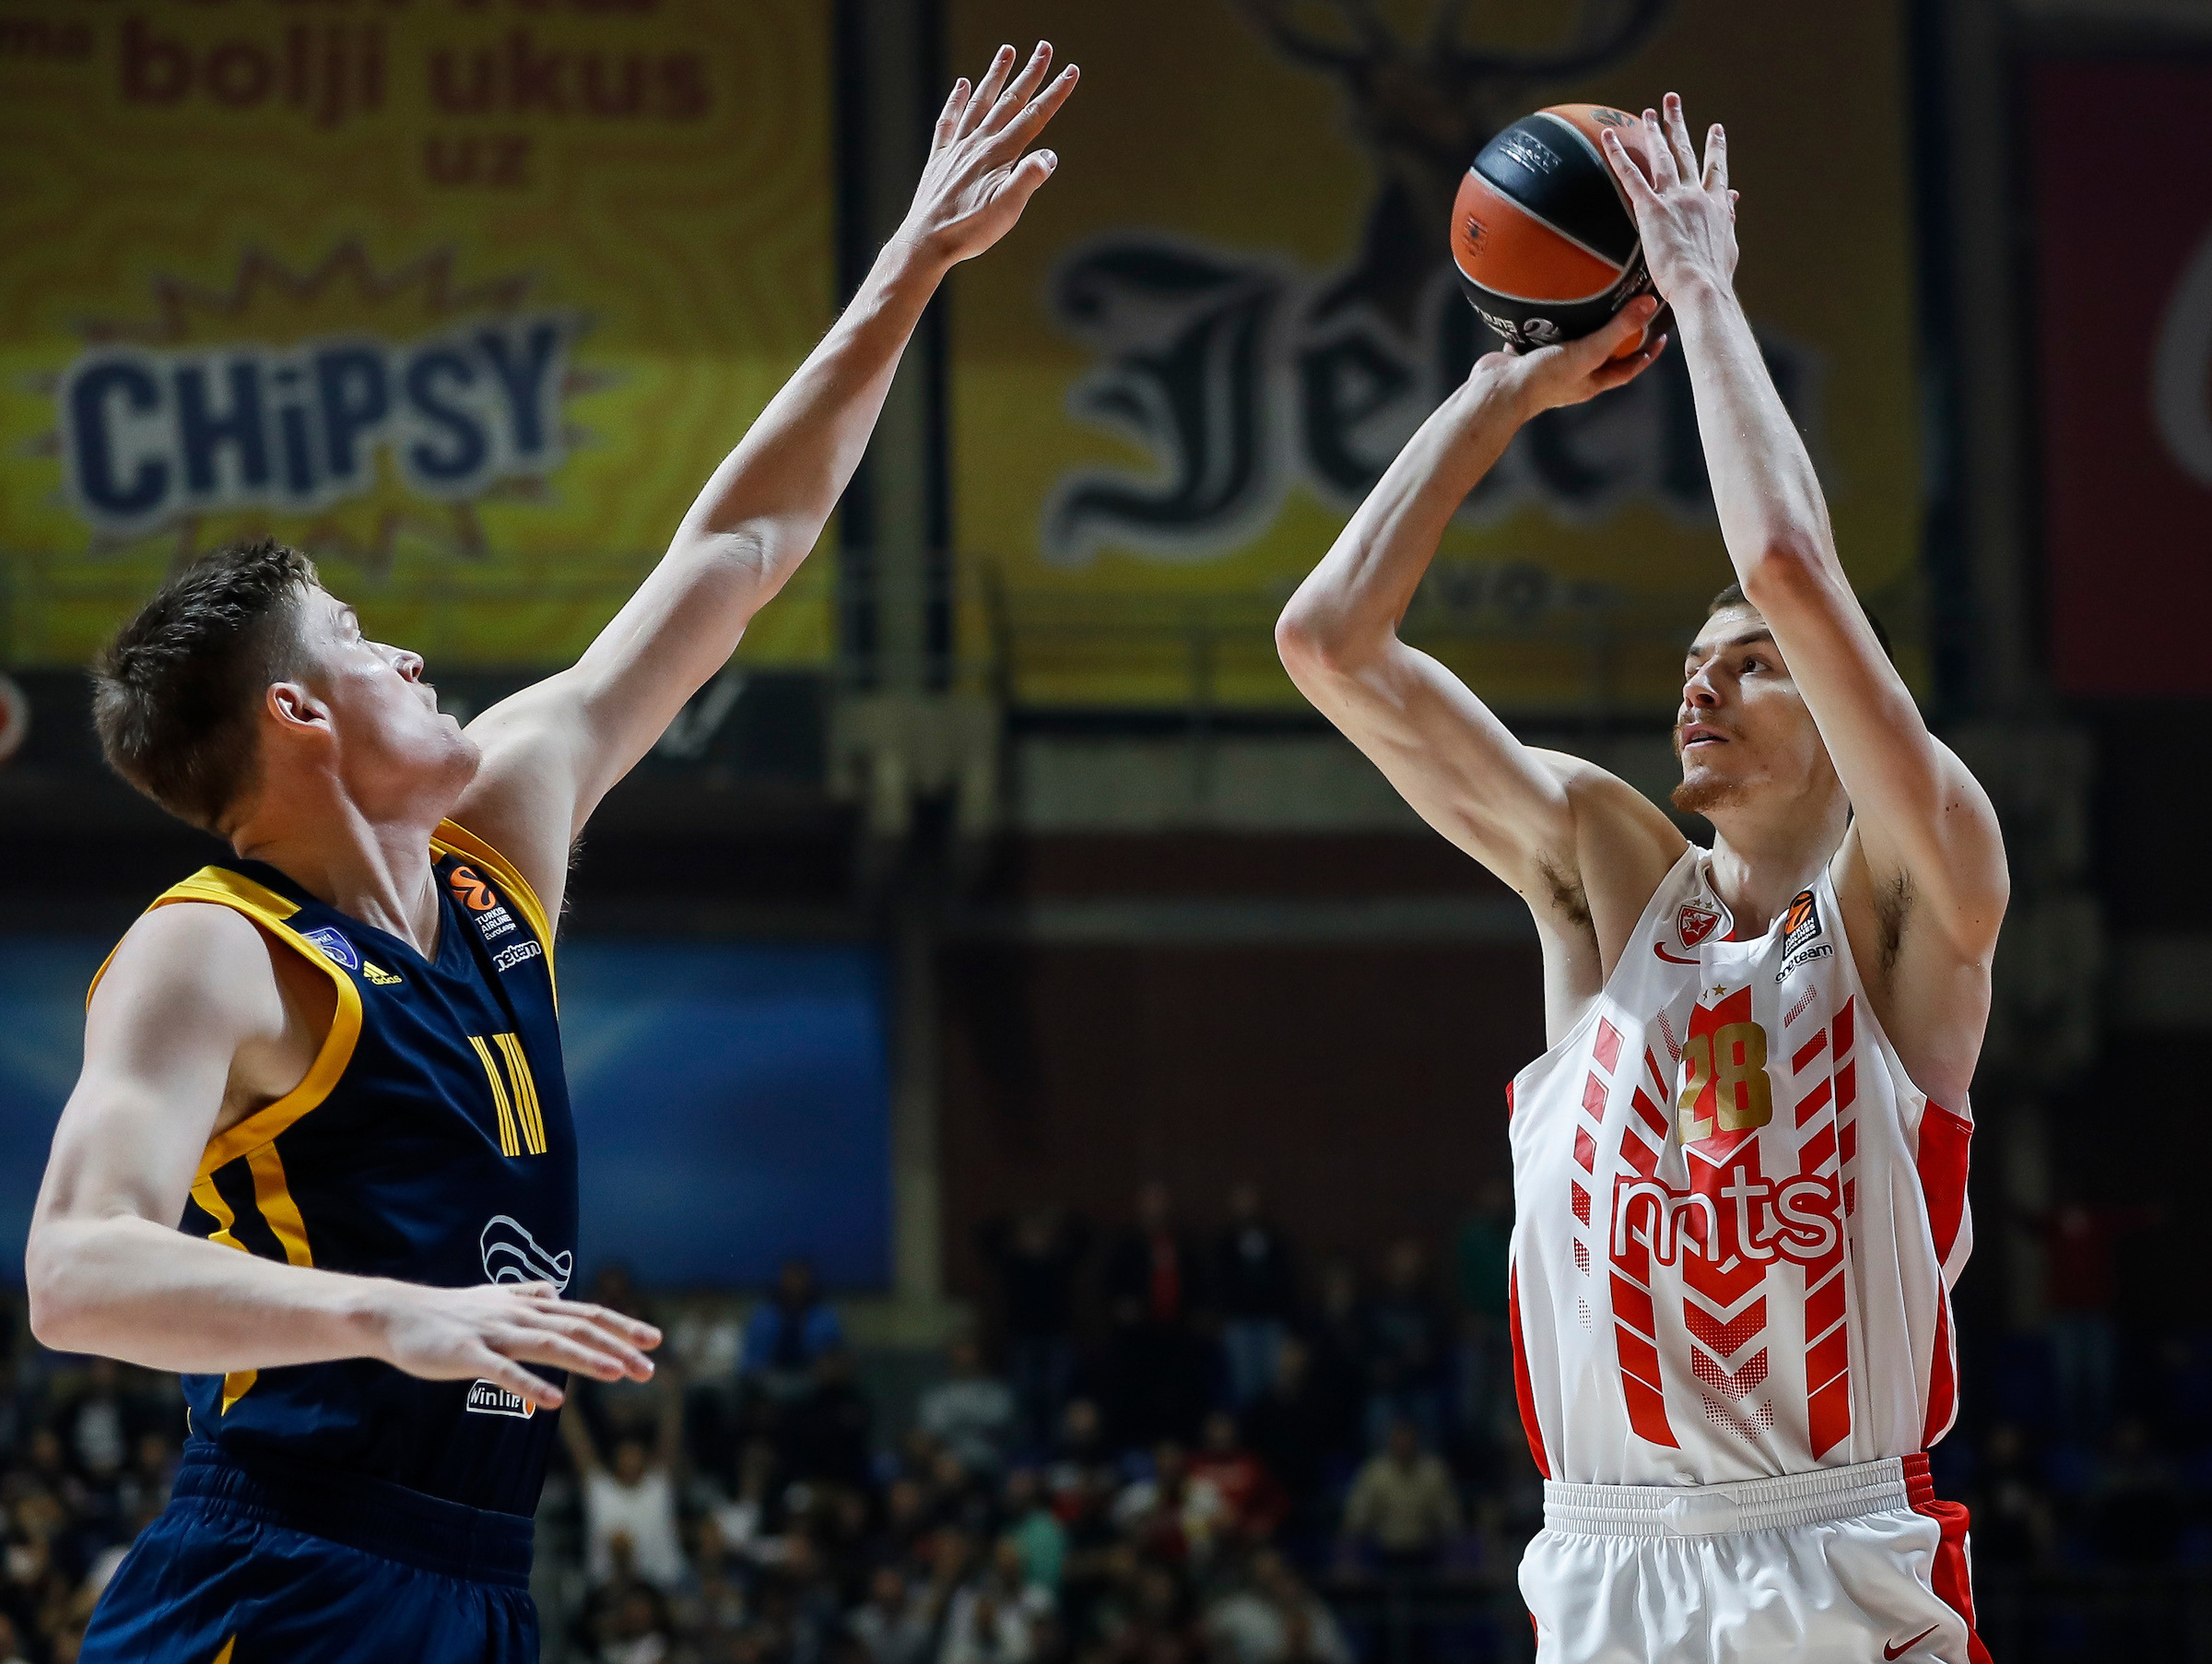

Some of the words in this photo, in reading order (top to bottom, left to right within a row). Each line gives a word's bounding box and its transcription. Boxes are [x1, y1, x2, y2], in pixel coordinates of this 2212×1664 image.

[121, 17, 384, 129] bolji
[428, 30, 713, 121] ukus
[424, 136, 535, 184] uz
[1677, 1021, 1773, 1146] 28
[1614, 1165, 1837, 1262] mts
